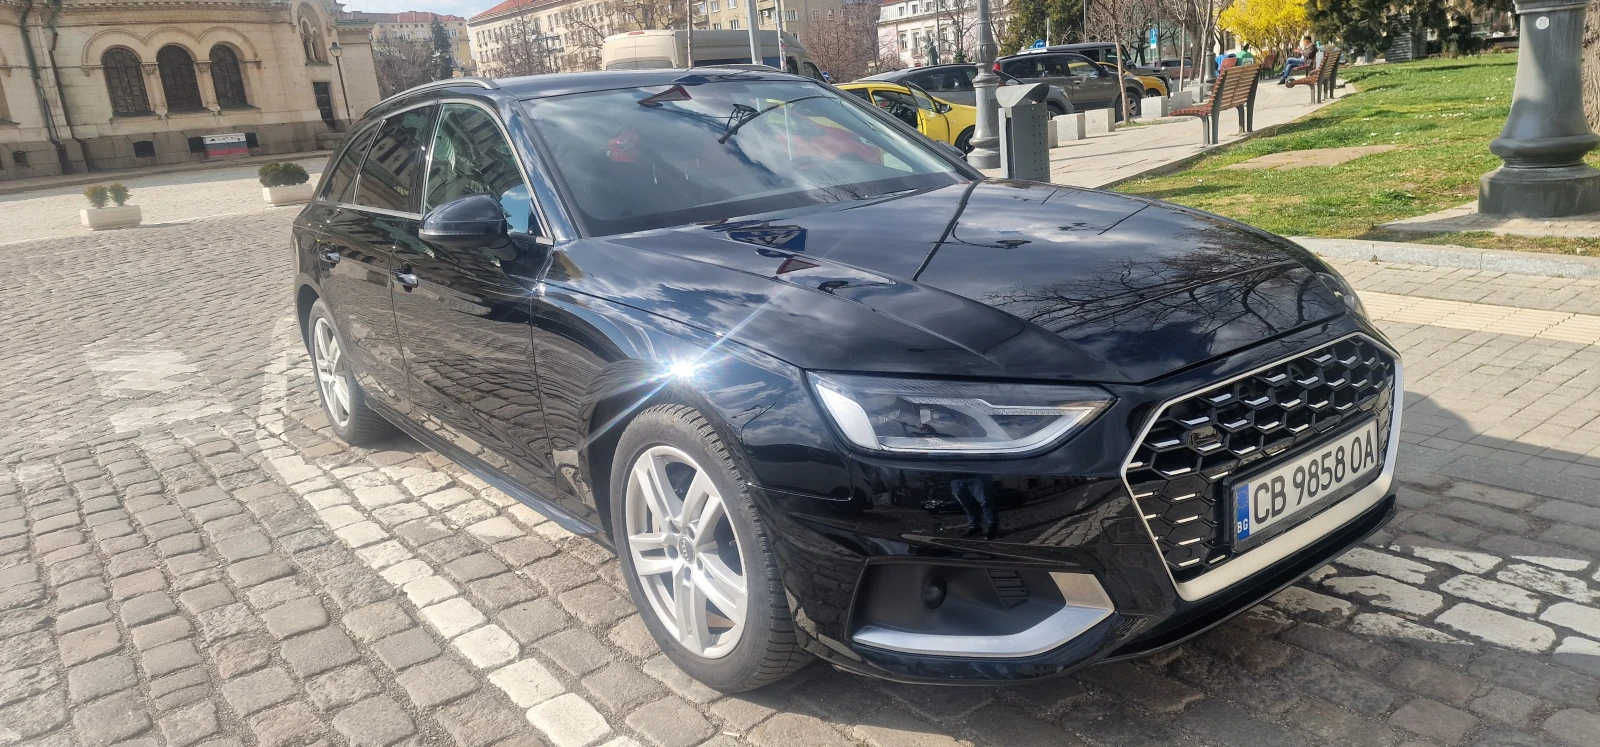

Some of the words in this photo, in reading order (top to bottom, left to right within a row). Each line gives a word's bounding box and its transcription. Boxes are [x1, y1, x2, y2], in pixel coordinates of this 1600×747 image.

[1253, 475, 1287, 525] CB
[1292, 445, 1346, 506] 9858
[1350, 429, 1375, 474] OA
[1237, 518, 1249, 534] BG
